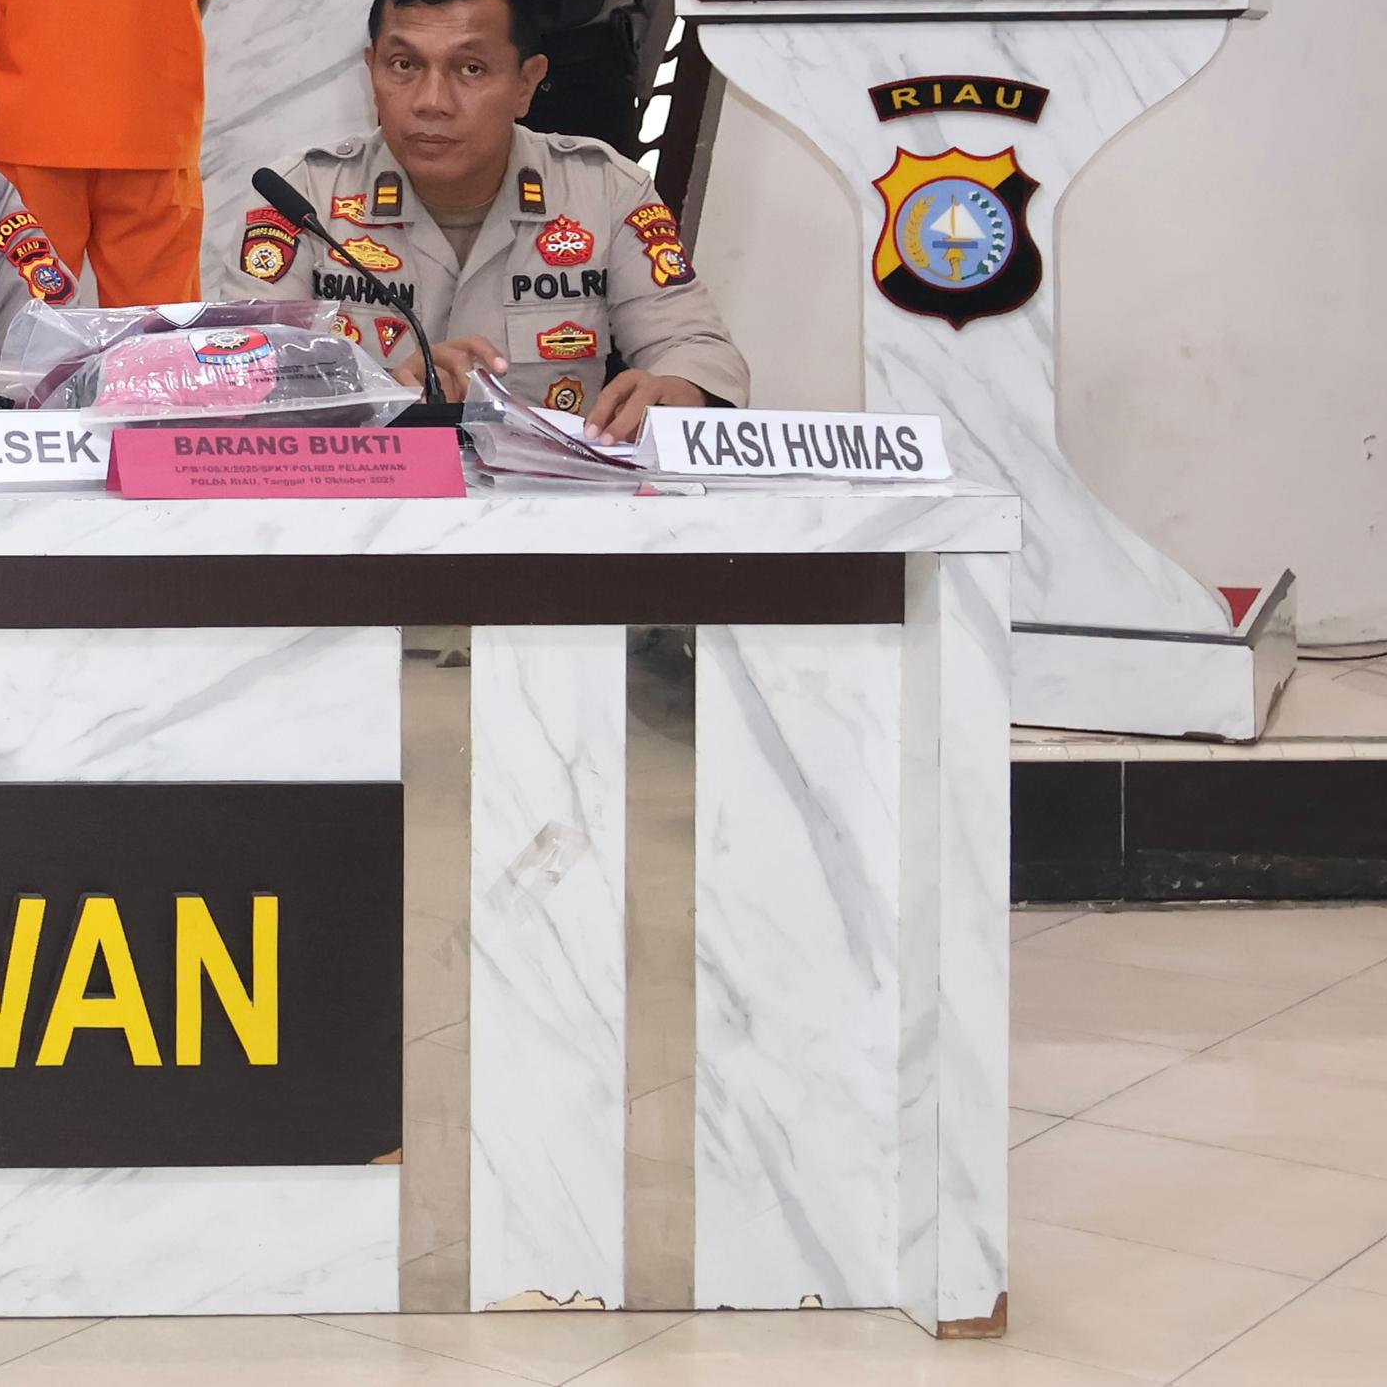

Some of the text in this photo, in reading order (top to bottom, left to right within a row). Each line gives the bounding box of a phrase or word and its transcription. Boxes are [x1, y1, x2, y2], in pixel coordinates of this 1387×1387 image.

[890, 84, 1024, 112] RIAU
[643, 227, 675, 238] RIAU
[16, 240, 40, 258] RIAU
[512, 268, 608, 301] POLRI
[174, 434, 402, 456] BARANG BUKTI
[682, 419, 925, 472] KASI HUMAS
[190, 477, 227, 486] POLDA
